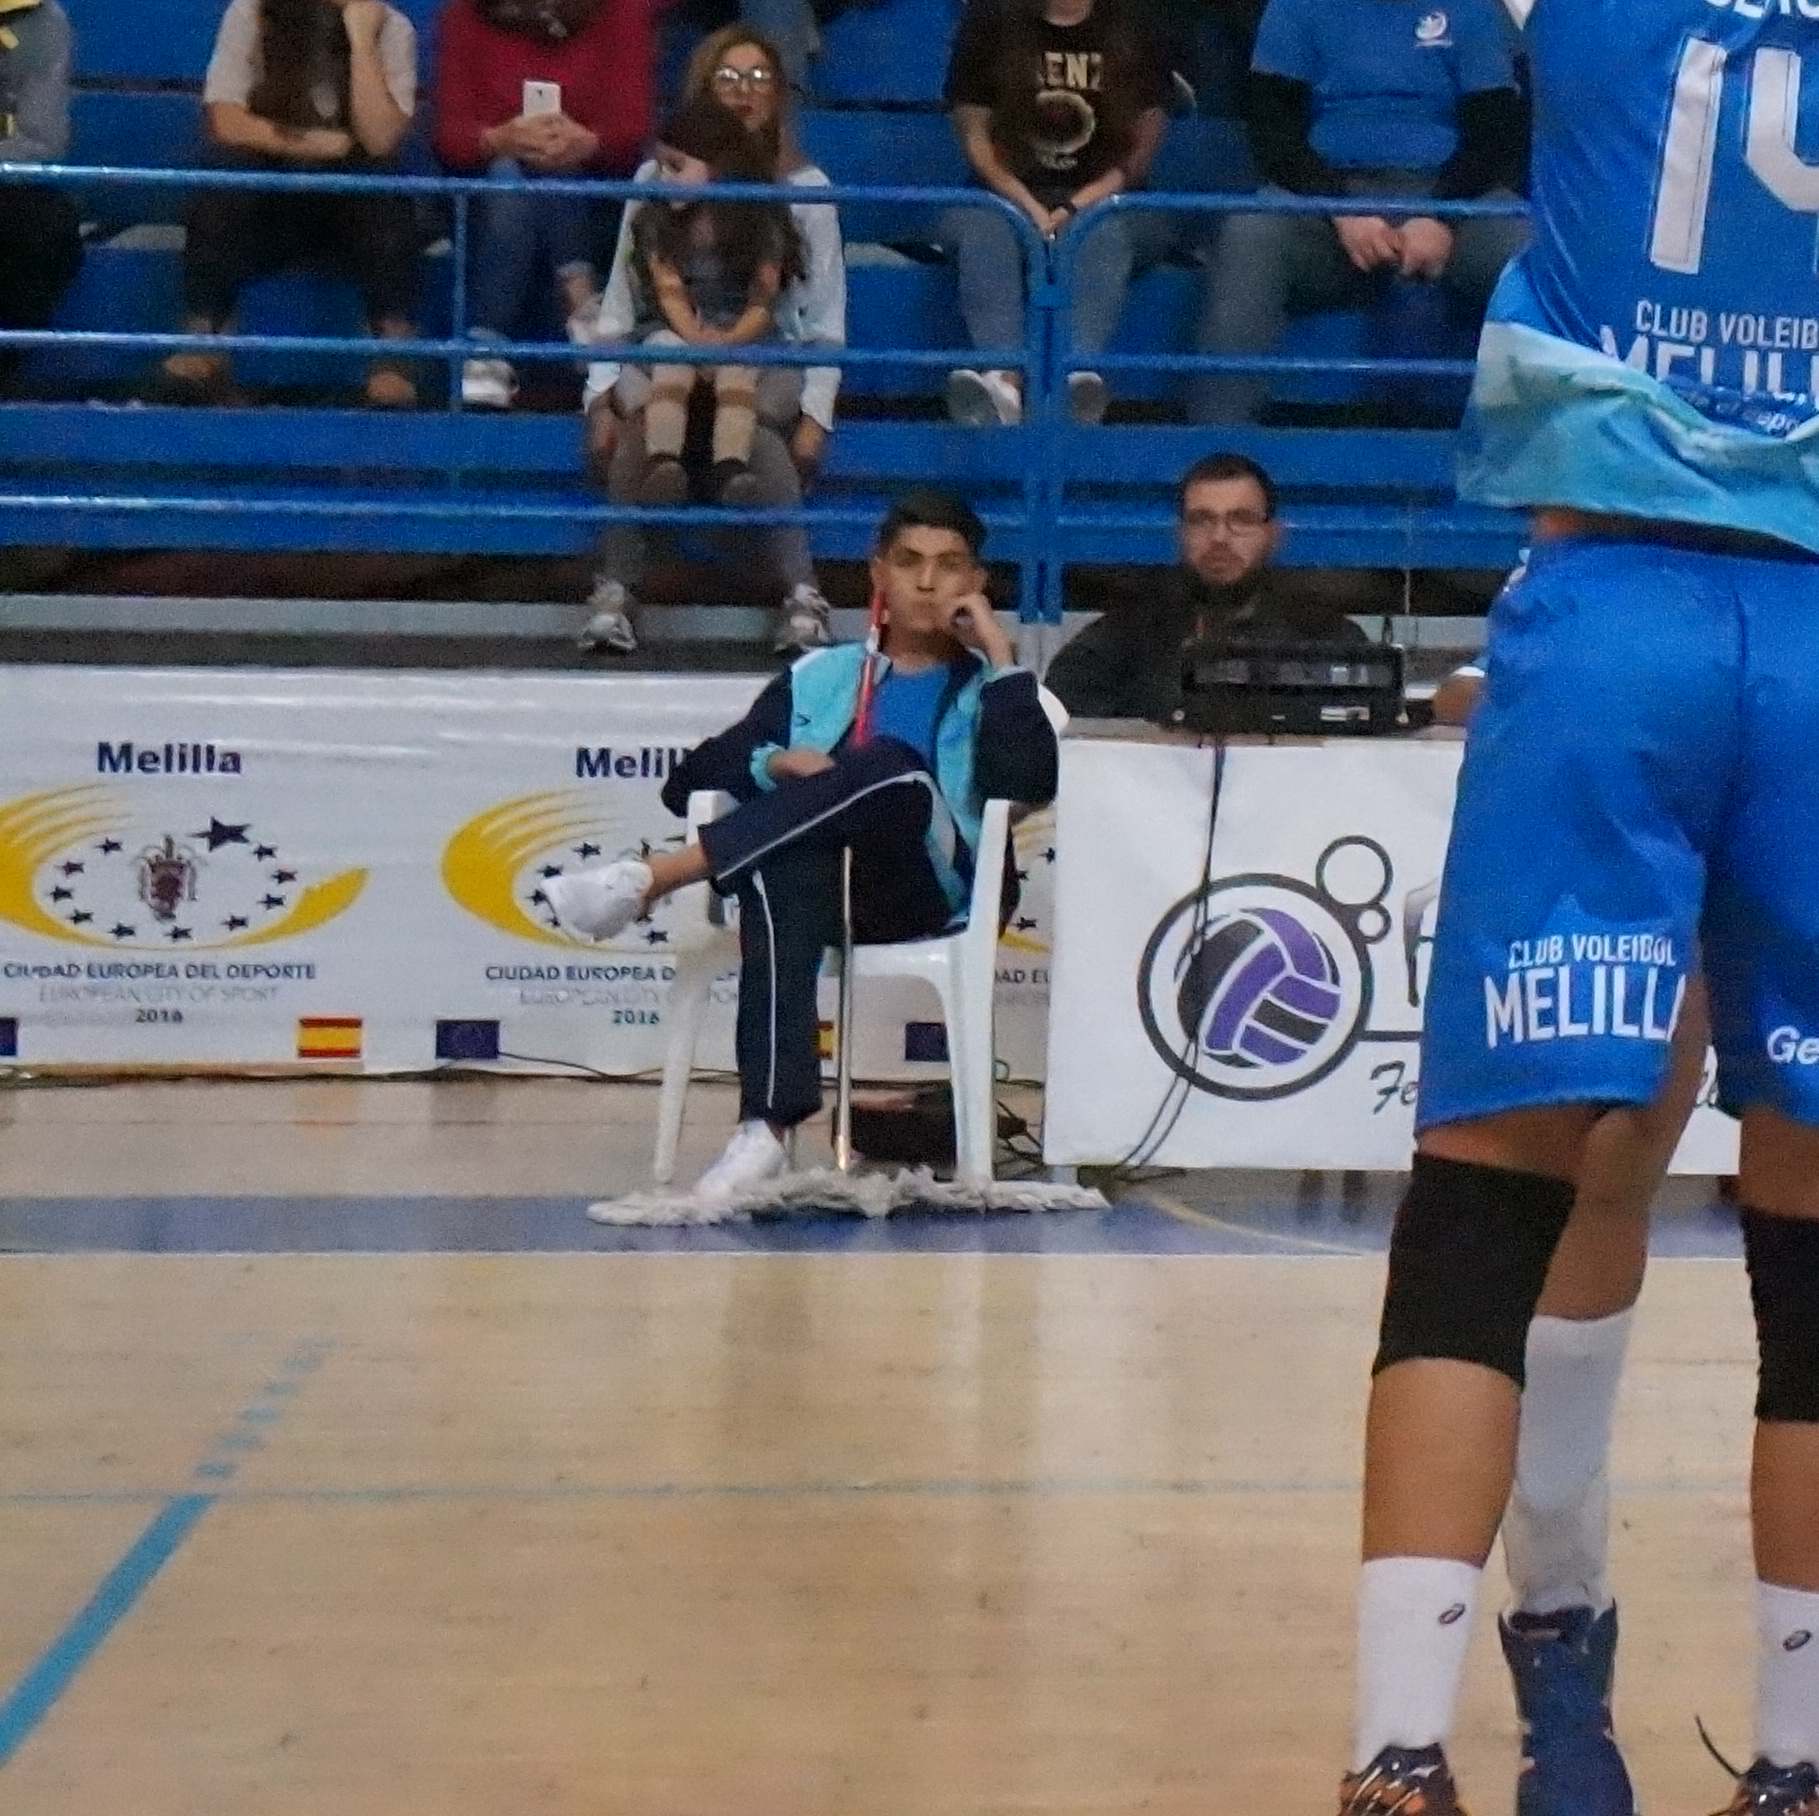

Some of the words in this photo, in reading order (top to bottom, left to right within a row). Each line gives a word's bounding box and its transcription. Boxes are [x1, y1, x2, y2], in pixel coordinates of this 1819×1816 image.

[1636, 299, 1708, 343] CLUB
[97, 742, 242, 774] Melilla
[1509, 937, 1565, 970] CLUB
[1572, 933, 1677, 966] VOLEIBOL
[4, 964, 81, 980] CIUDAD
[87, 964, 179, 980] EUROPEA
[185, 964, 219, 980] DEL
[226, 964, 315, 980] DEPORTE
[486, 966, 560, 981] CIUDAD
[567, 966, 659, 981] EUROPEA
